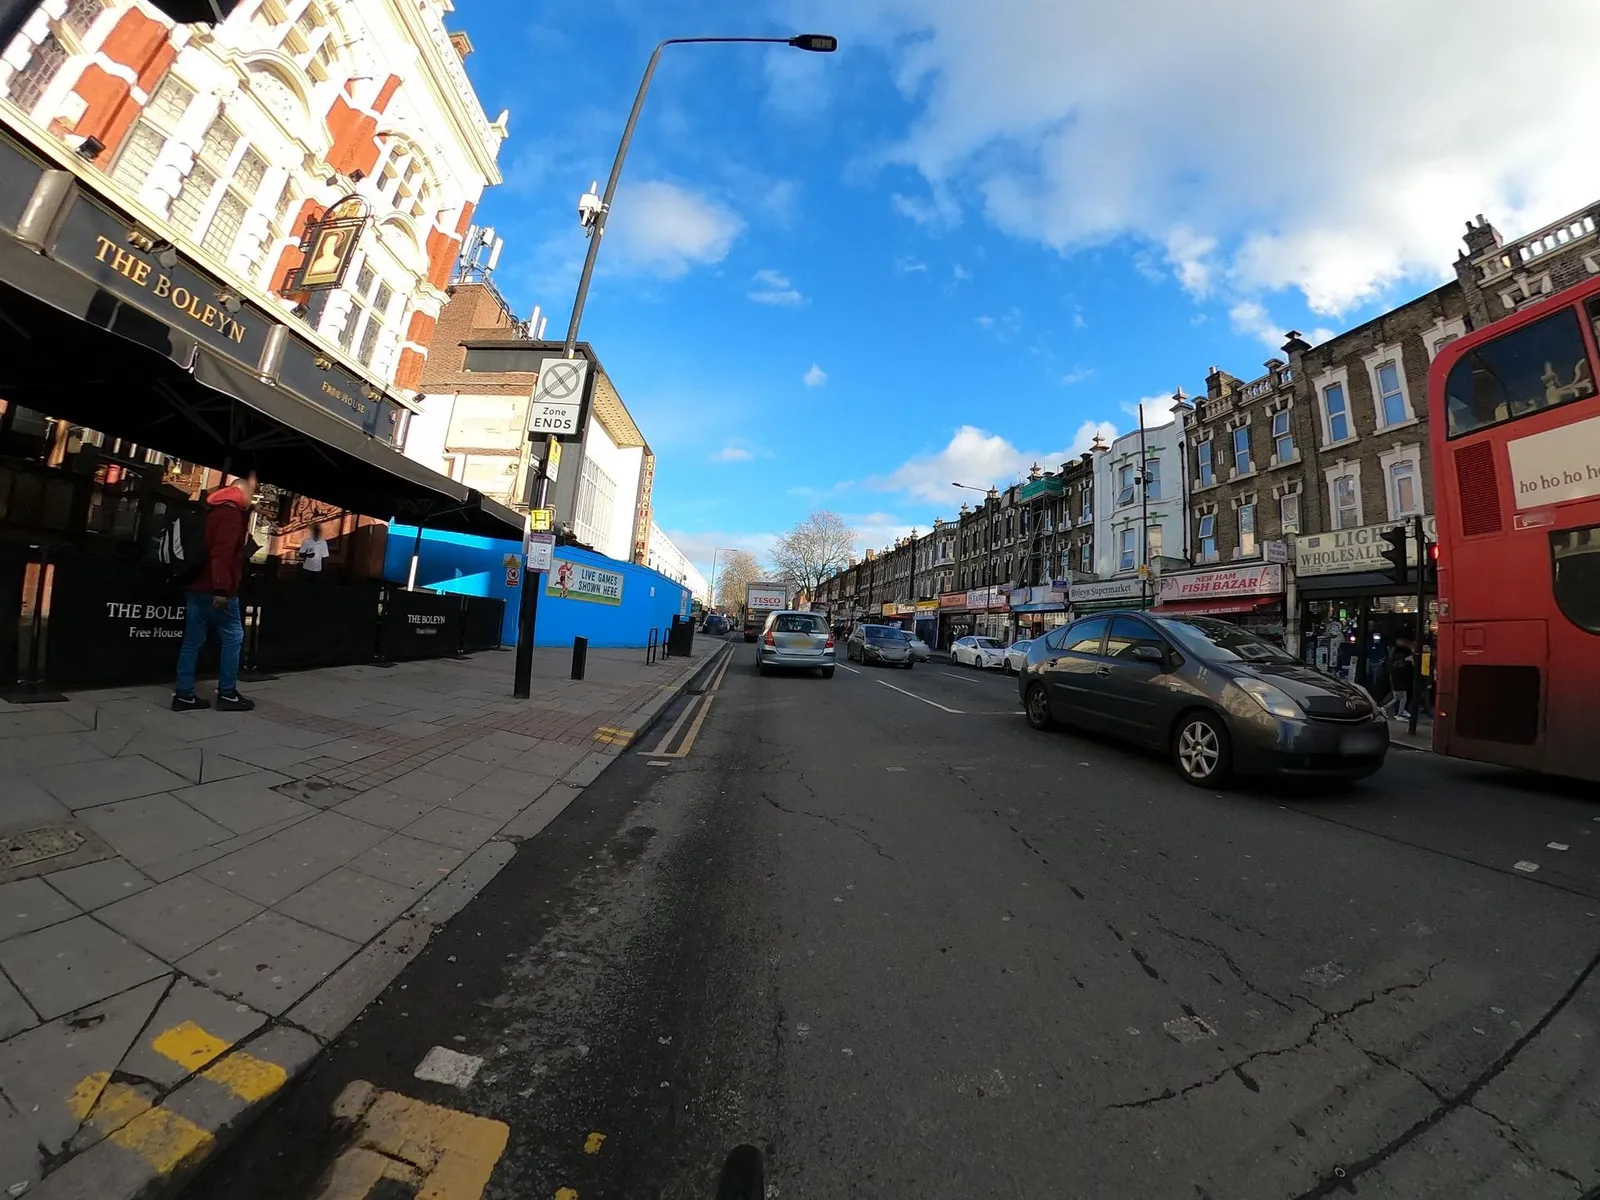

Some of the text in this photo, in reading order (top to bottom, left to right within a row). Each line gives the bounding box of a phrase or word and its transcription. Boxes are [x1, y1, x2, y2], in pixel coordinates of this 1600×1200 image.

[94, 235, 247, 344] THE BOLEYN
[543, 407, 567, 417] Zone
[534, 418, 572, 429] ENDS
[1520, 480, 1537, 493] ho
[1540, 475, 1560, 489] ho
[1563, 470, 1582, 485] ho
[581, 569, 618, 586] LIVE GAMES
[1195, 572, 1236, 583] NEW HAM
[578, 580, 618, 597] SHOWN HERE
[1071, 583, 1132, 599] Boleyn Supermarket
[1181, 582, 1210, 593] FISH
[1212, 578, 1258, 591] BAZAR
[752, 596, 781, 604] TESCO
[106, 602, 185, 620] THE BOLE
[407, 614, 446, 625] THE BOLEYN
[129, 626, 183, 638] Free House
